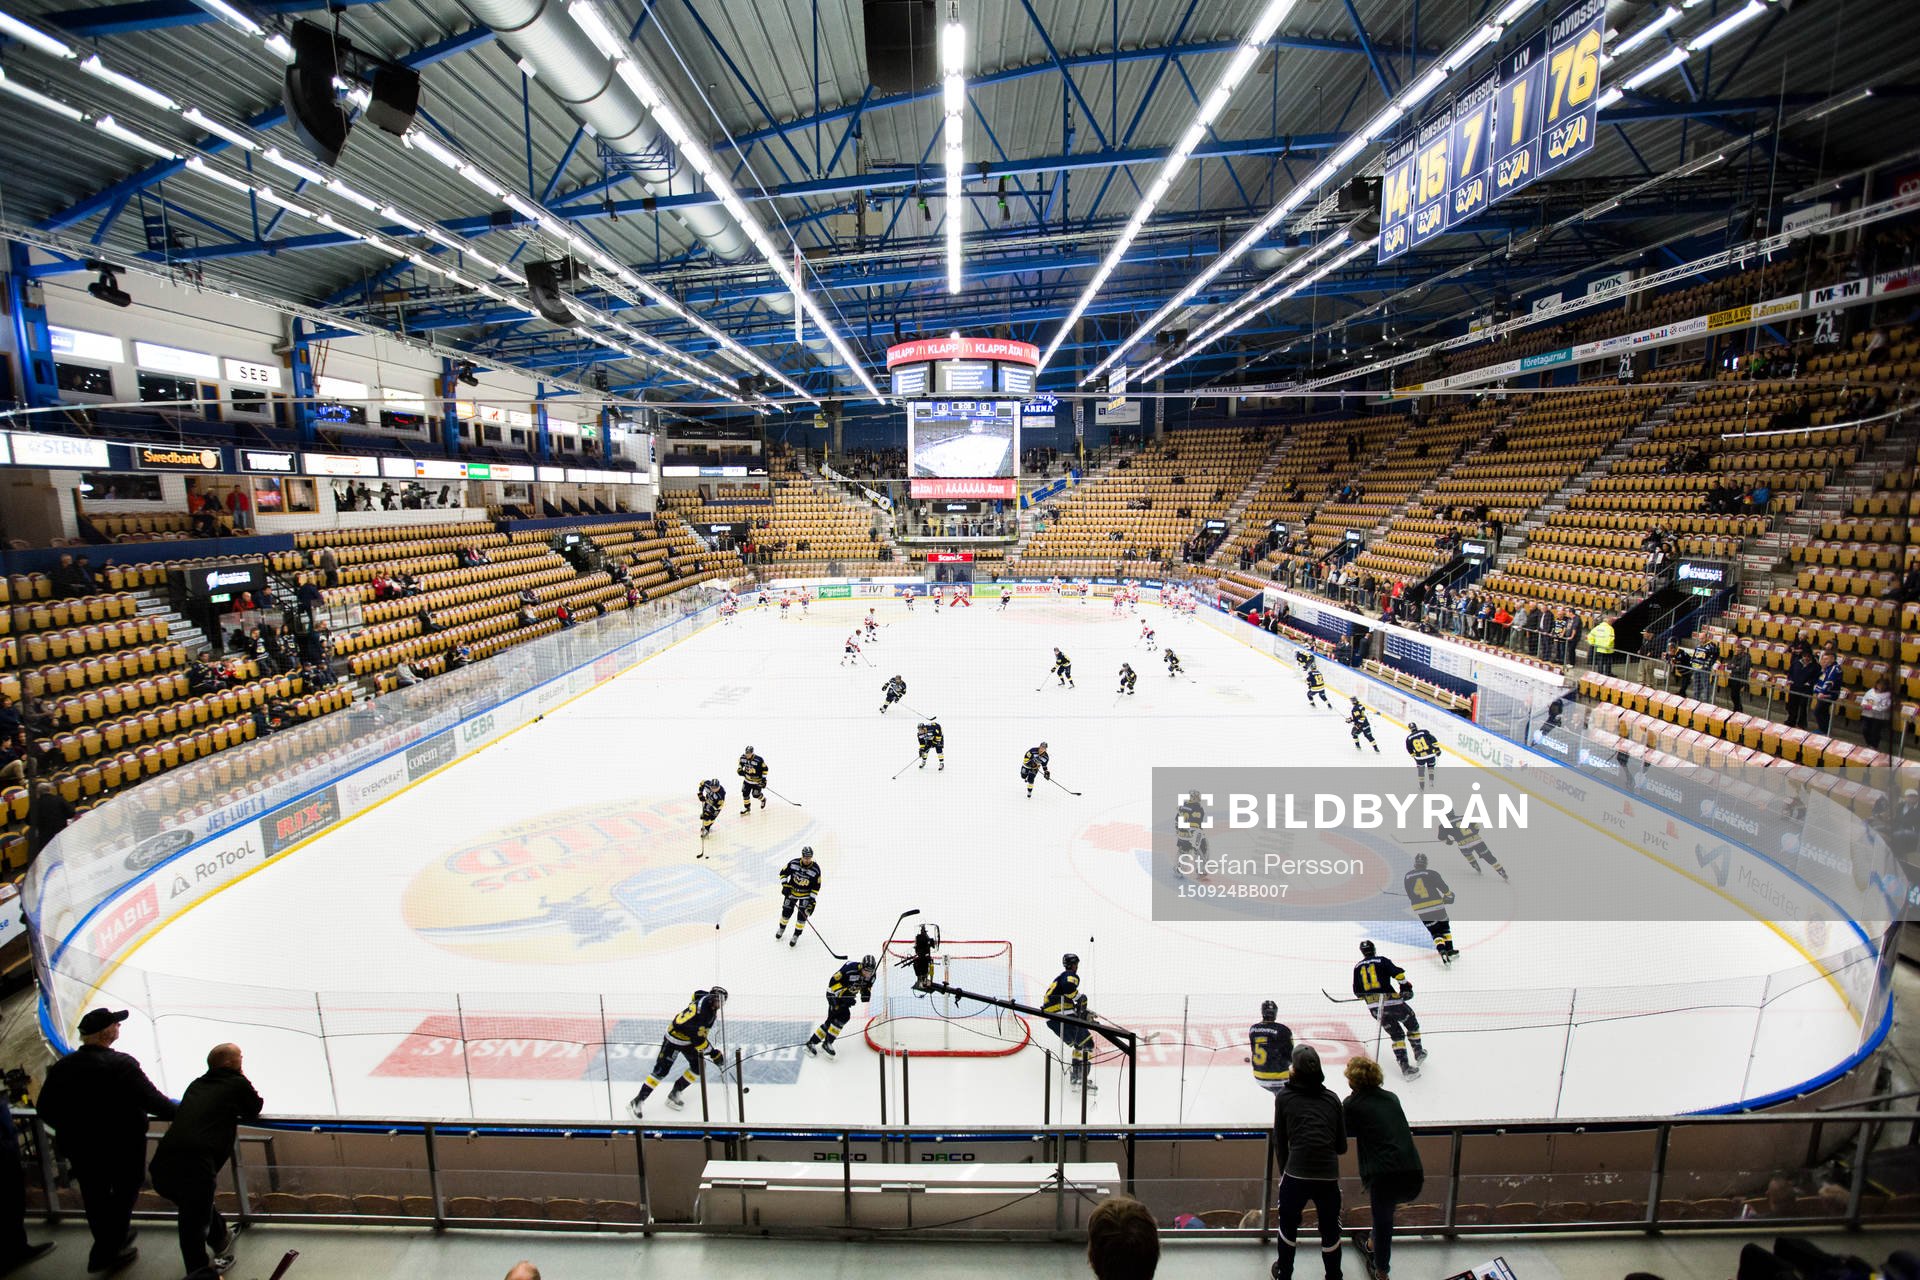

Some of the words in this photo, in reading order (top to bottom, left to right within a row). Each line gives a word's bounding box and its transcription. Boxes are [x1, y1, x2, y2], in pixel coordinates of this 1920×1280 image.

[1514, 47, 1530, 73] LIV
[1548, 29, 1601, 122] 76
[1511, 80, 1527, 146] 1
[1461, 111, 1484, 178] 7
[1418, 139, 1447, 205] 15
[1385, 165, 1410, 224] 14
[1633, 330, 1668, 344] samhall
[1679, 320, 1706, 333] eurofins
[1524, 353, 1568, 368] företagarna
[239, 366, 269, 382] SEB
[39, 440, 93, 457] STENA
[143, 450, 200, 466] Swedbank
[868, 585, 885, 593] IVT
[463, 714, 495, 742] LEBA
[1412, 737, 1429, 752] 81
[276, 803, 322, 839] RIX
[1603, 811, 1626, 830] pwc
[1643, 830, 1669, 851] pwc
[1413, 877, 1430, 899] 4
[100, 894, 155, 944] HABIL
[1360, 963, 1382, 992] 11
[1252, 1036, 1269, 1066] 5
[921, 1152, 976, 1162] DACO
